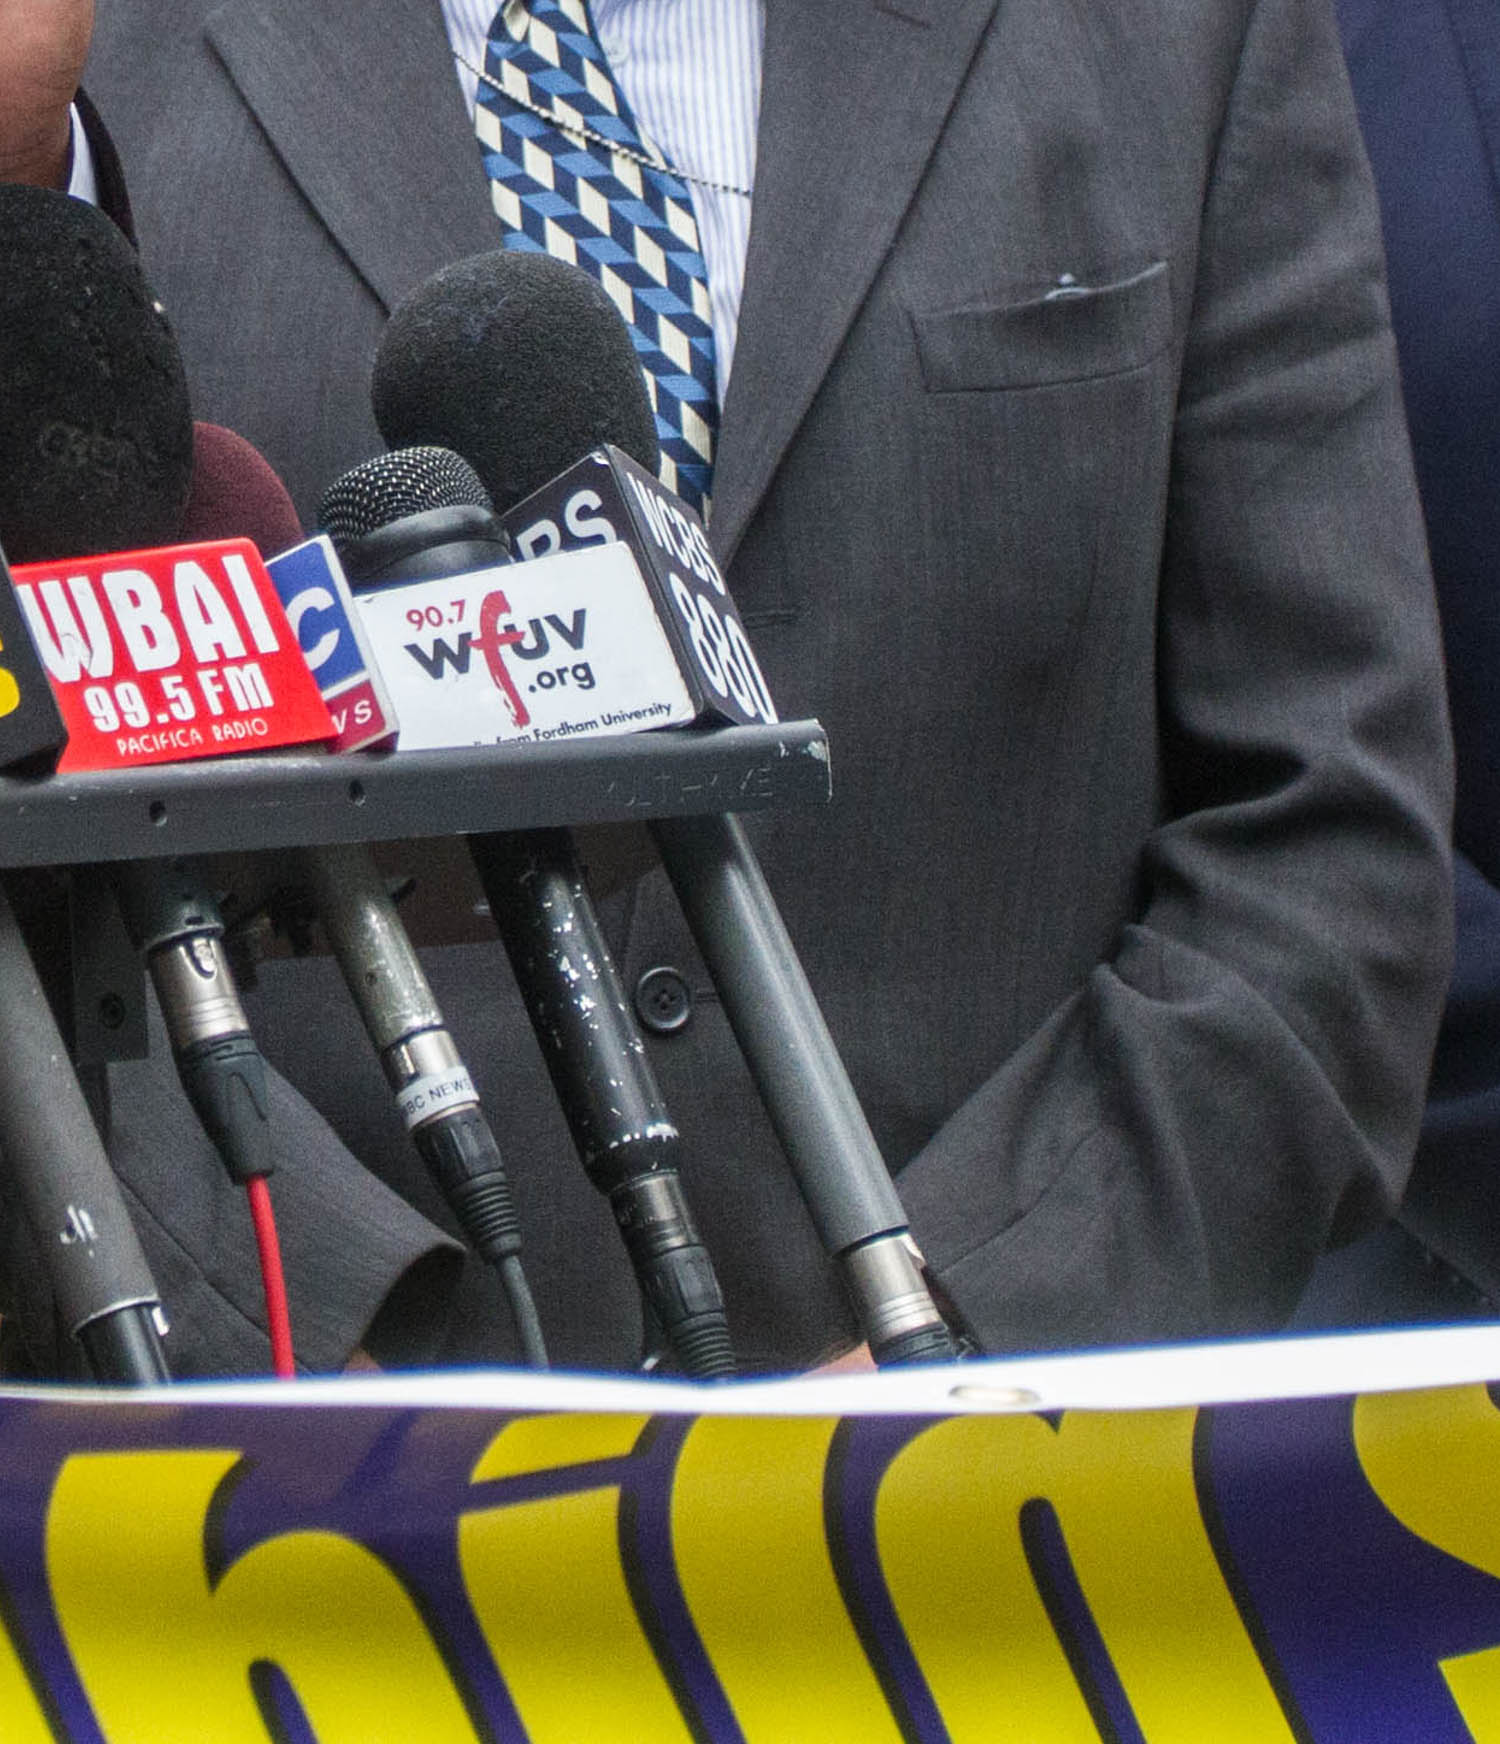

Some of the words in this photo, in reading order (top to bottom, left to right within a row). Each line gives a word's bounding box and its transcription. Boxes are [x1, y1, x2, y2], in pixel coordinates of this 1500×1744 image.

[626, 472, 726, 596] WCBS
[15, 554, 280, 683] WBAI
[406, 599, 466, 632] 90.7
[669, 572, 779, 725] 880
[84, 675, 196, 732] 99.5
[197, 663, 274, 716] FM
[528, 662, 596, 693] .org
[117, 731, 204, 756] PACIFICA
[212, 717, 268, 742] RADIO
[533, 720, 600, 742] Fordham
[602, 702, 673, 727] University
